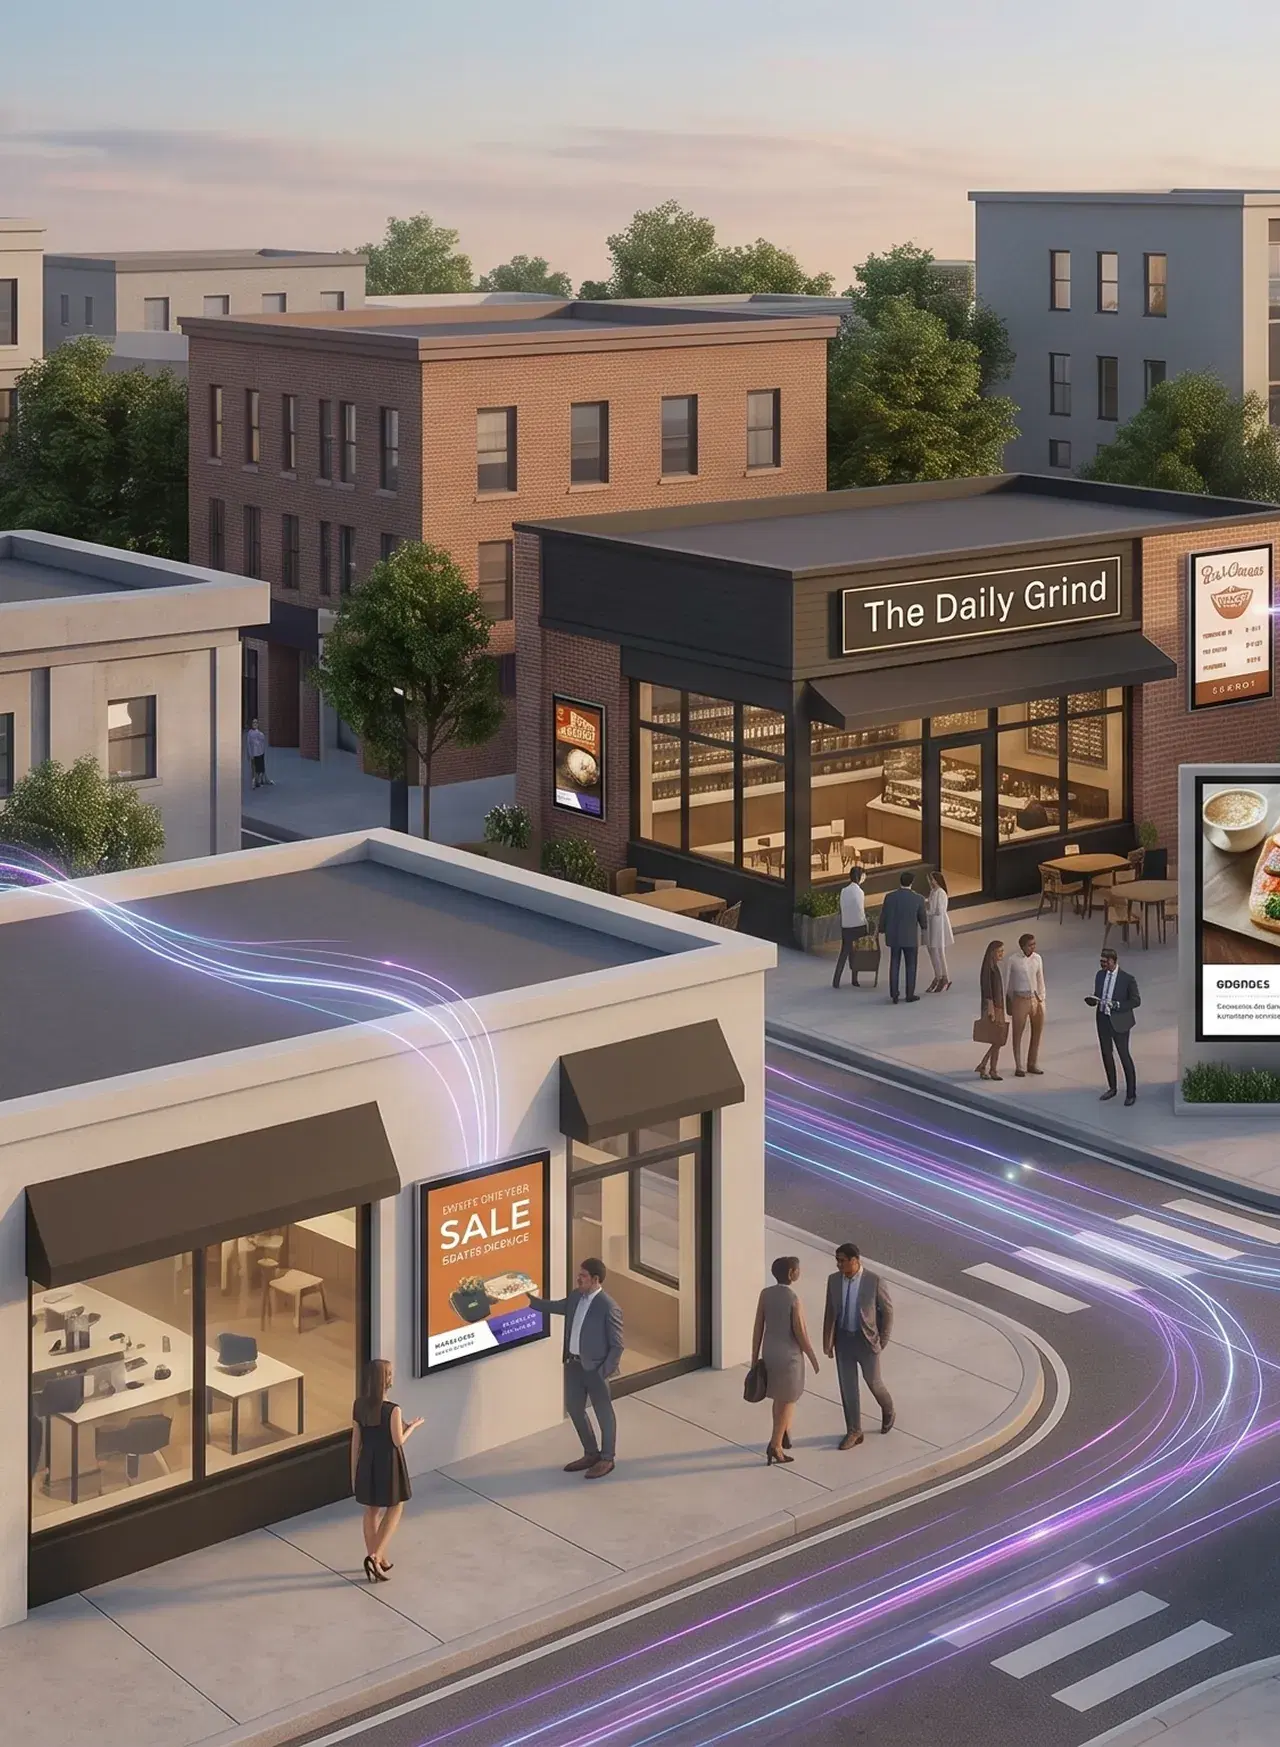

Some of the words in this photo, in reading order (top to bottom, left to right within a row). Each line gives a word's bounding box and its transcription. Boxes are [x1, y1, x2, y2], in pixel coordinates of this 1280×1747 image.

[863, 599, 925, 632] The
[936, 586, 1015, 623] Daily
[1024, 571, 1107, 610] Grind
[440, 1198, 532, 1250] SALE
